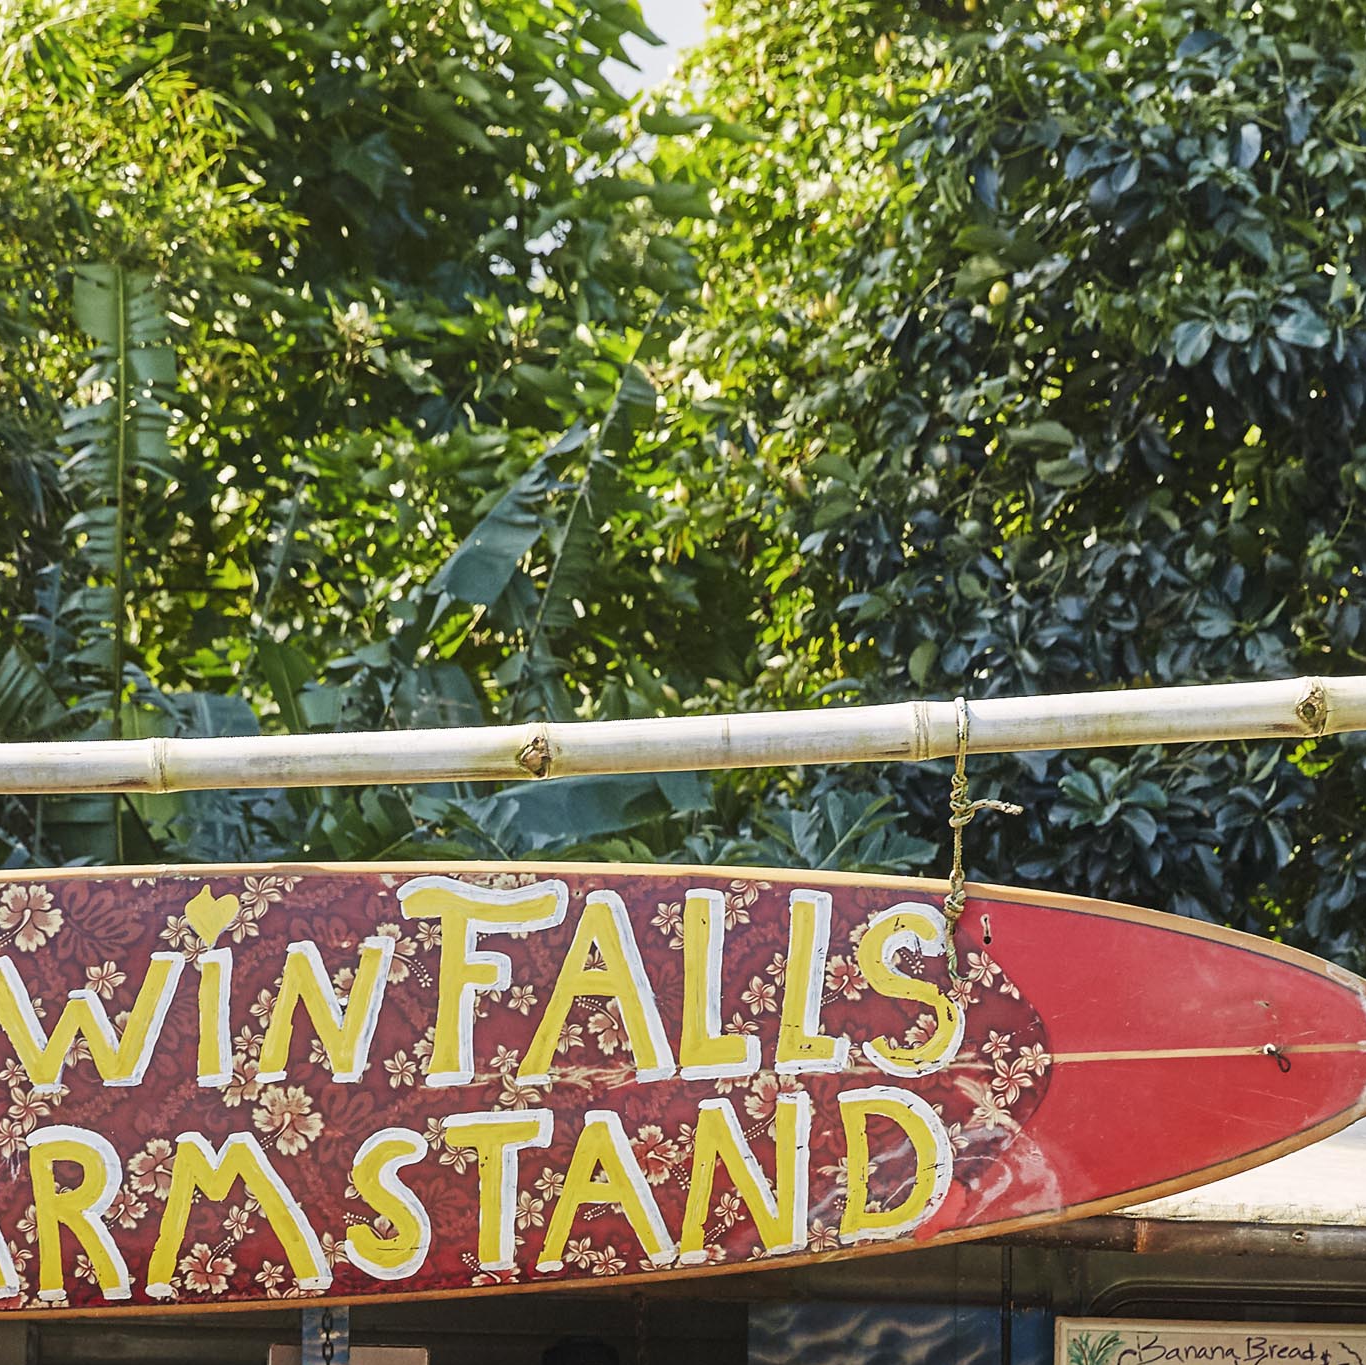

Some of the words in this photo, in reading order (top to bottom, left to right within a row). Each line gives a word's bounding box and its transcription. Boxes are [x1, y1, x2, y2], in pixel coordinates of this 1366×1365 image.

[398, 874, 967, 1087] FALLS
[1137, 1335, 1237, 1365] Banana
[1244, 1337, 1316, 1361] Bread
